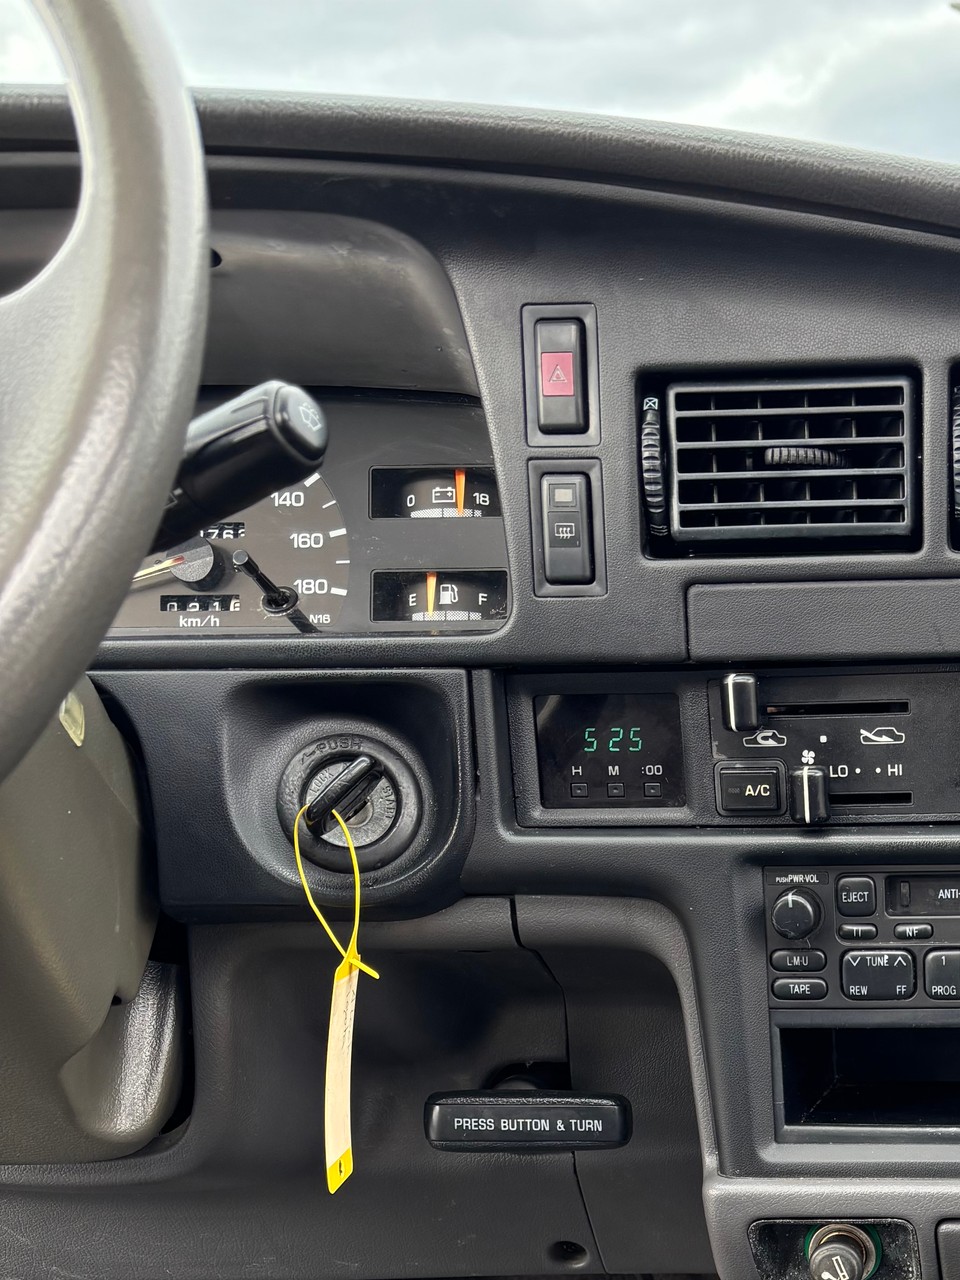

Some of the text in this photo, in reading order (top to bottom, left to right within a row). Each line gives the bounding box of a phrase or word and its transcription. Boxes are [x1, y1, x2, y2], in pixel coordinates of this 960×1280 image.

[270, 491, 304, 507] 140
[406, 492, 490, 507] 0 18
[290, 533, 323, 548] 160
[293, 579, 328, 594] 180
[409, 592, 488, 607] E F
[179, 615, 220, 627] km/h
[318, 738, 363, 753] PUSH
[571, 765, 583, 776] H
[608, 765, 620, 776] M
[829, 764, 849, 777] LO
[887, 763, 903, 777] HI
[745, 783, 770, 797] A/C
[842, 891, 869, 902] EJECT
[906, 926, 919, 937] NF
[866, 956, 890, 967] TUNE
[940, 957, 946, 966] 1
[789, 984, 811, 995] TAPE
[850, 985, 868, 995] REW
[896, 985, 907, 995] FF
[932, 985, 957, 995] PROG
[454, 1118, 602, 1132] PRESS BUTTON & TURN
